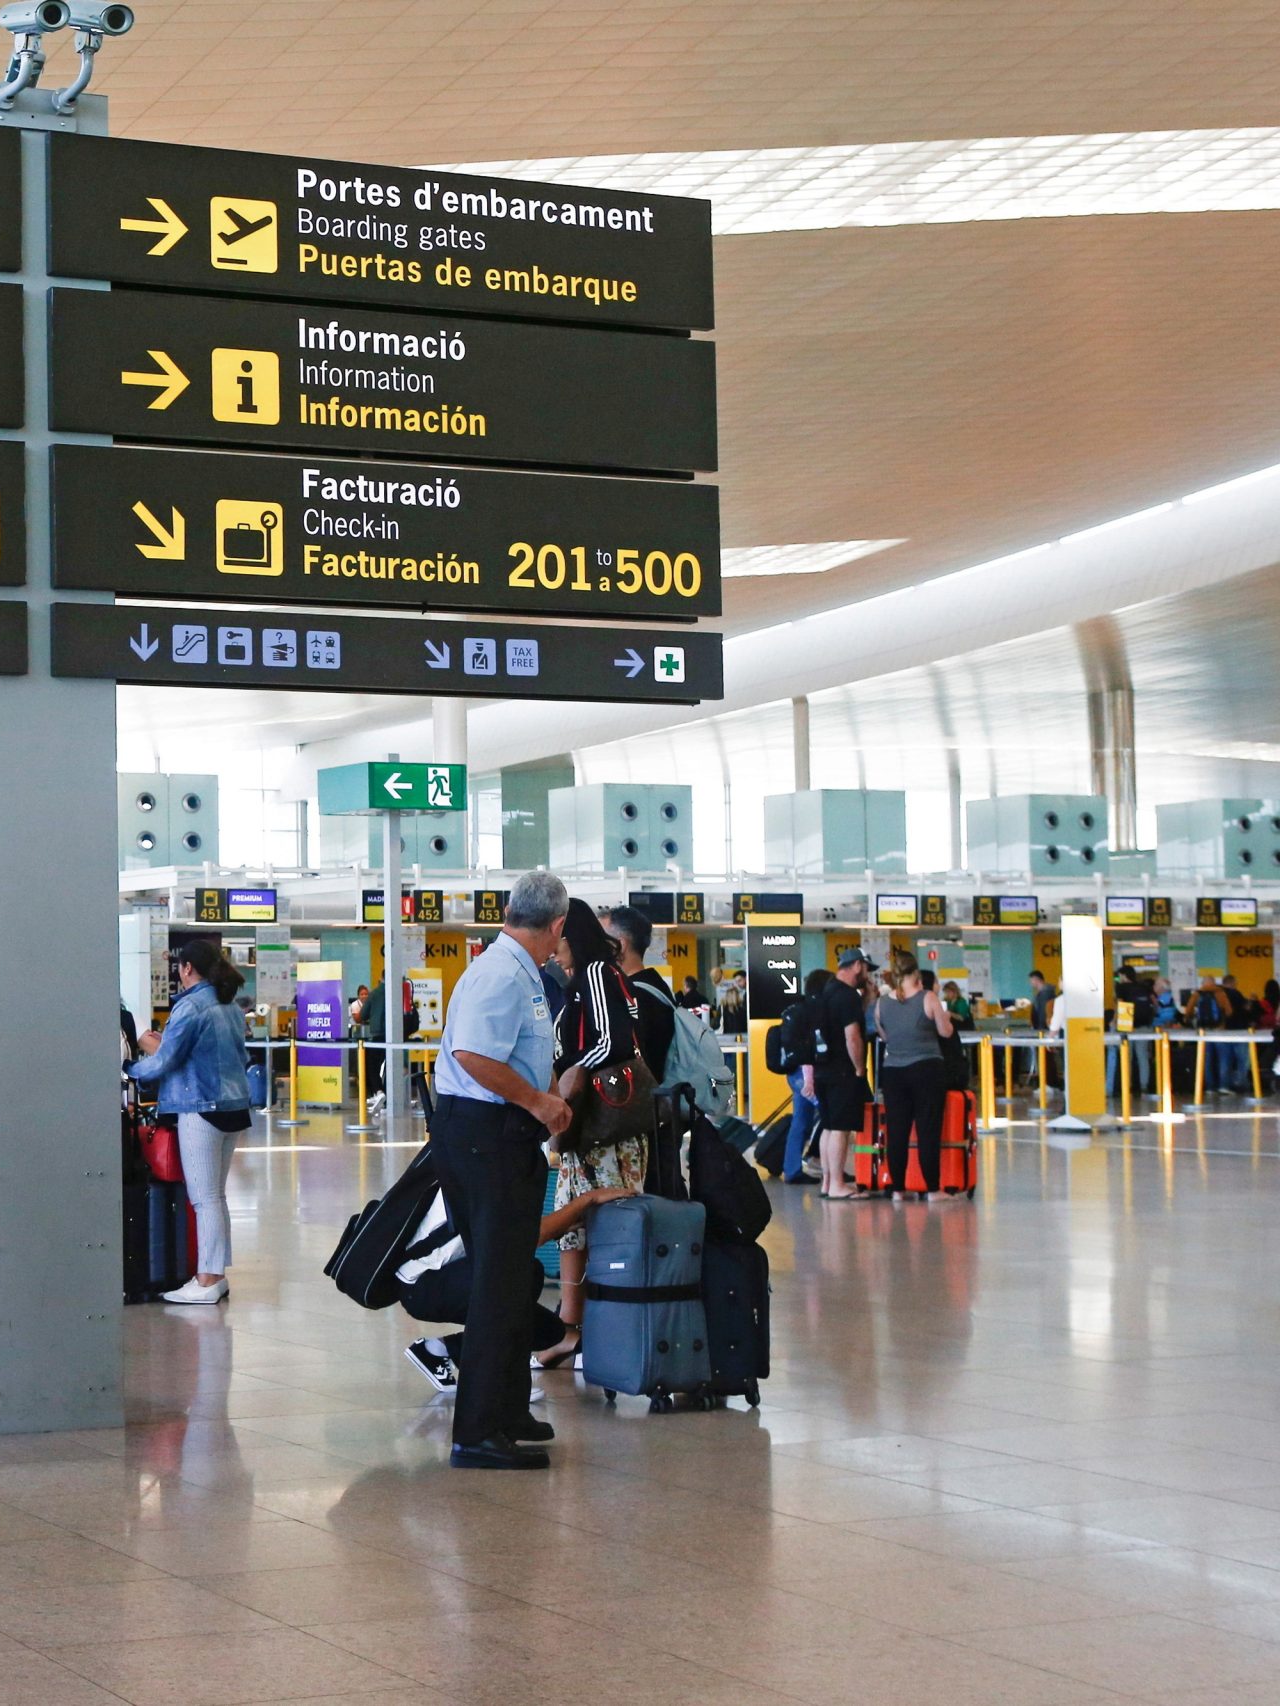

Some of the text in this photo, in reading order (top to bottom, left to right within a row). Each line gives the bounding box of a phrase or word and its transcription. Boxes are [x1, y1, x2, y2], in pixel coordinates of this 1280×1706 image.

[297, 168, 401, 208] Portes
[297, 207, 487, 252] Boarding gates
[299, 243, 637, 306] Puertas de embarque
[298, 318, 466, 361] Informació
[299, 358, 435, 394] Information
[299, 393, 486, 437] Información
[302, 468, 461, 509] Facturació
[303, 508, 400, 540] Check-in
[303, 541, 702, 598] Facturación 201 to 500
[598, 576, 611, 592] a
[512, 646, 532, 657] TAX
[511, 658, 535, 668] FREE
[232, 894, 263, 902] PREMIUM
[200, 908, 222, 920] 451
[418, 909, 440, 921] 452
[478, 909, 500, 921] 453
[680, 911, 702, 923] 454
[762, 935, 796, 946] MADRID
[307, 1003, 331, 1014] PREMIUM
